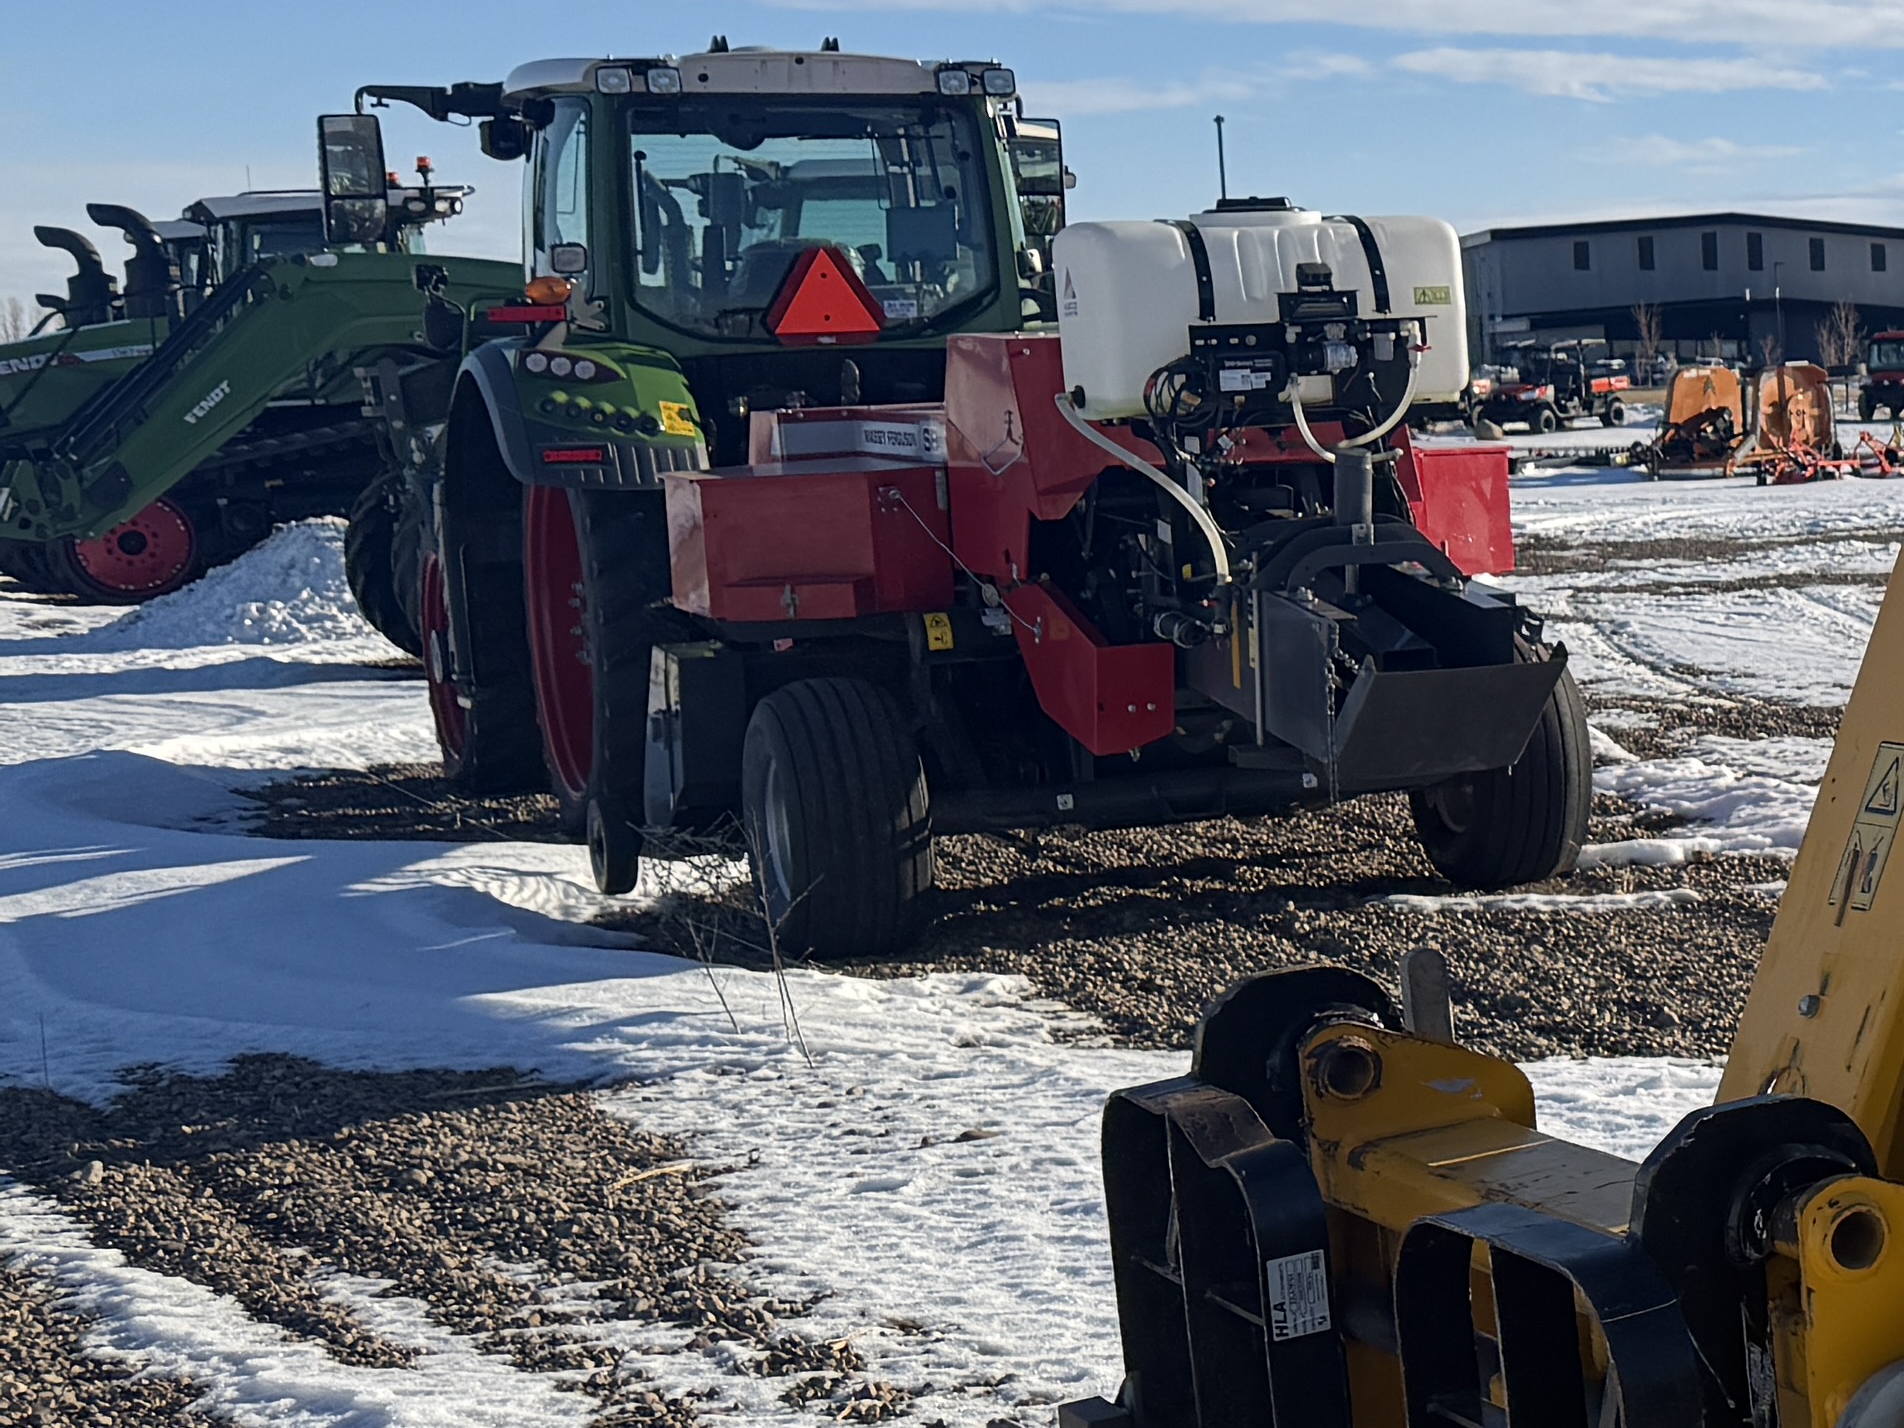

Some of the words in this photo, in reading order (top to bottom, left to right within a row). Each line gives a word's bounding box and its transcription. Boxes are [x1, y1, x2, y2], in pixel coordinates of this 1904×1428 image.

[0, 351, 64, 375] ENDT
[184, 379, 232, 424] FENDT
[1272, 1301, 1290, 1338] HLA
